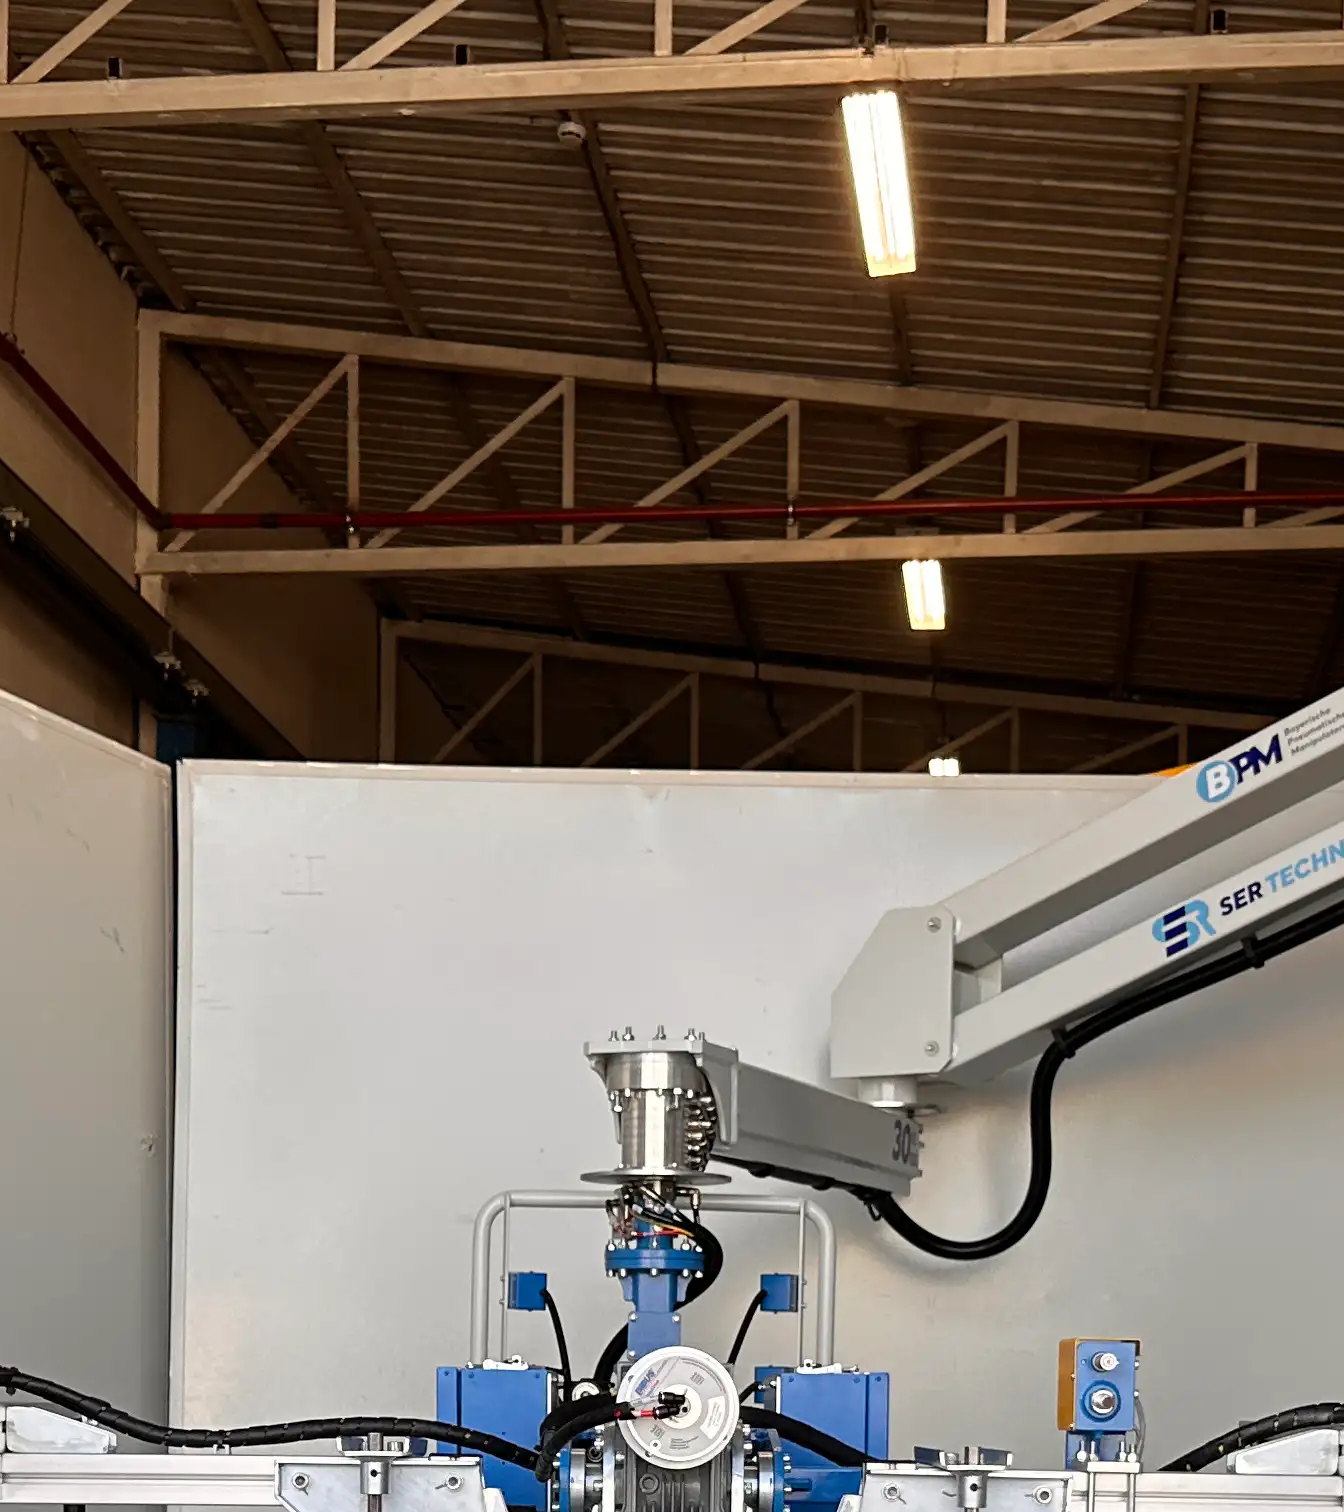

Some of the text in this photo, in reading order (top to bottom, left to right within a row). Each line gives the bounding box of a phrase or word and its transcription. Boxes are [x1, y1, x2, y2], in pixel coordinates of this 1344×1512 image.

[1283, 708, 1331, 737] Bayerische
[1202, 733, 1283, 800] BPM
[1220, 881, 1263, 916] SER
